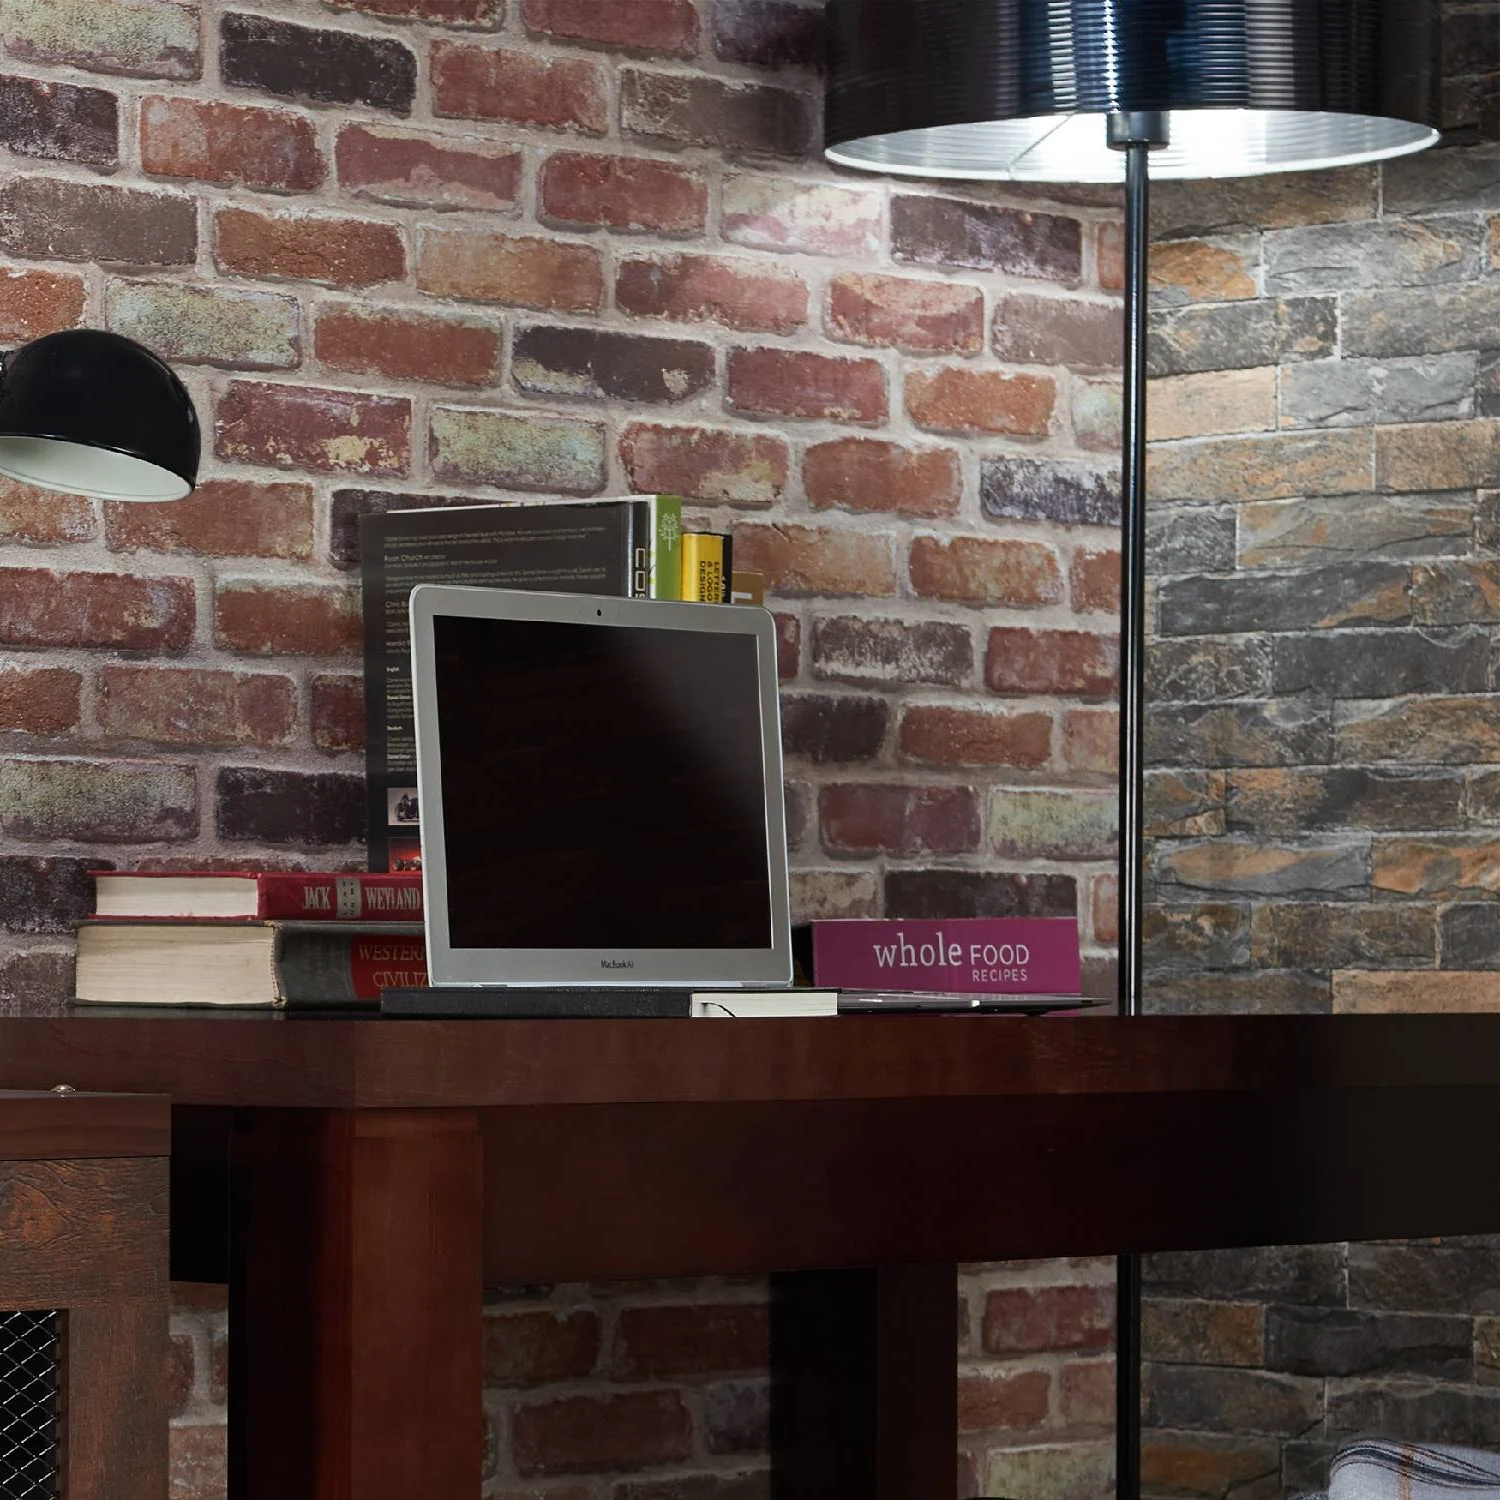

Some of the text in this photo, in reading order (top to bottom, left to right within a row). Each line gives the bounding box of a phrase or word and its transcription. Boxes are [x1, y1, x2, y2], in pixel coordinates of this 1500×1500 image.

[635, 547, 646, 598] CO
[302, 886, 421, 911] JACK WEYLAND
[358, 944, 425, 961] WESTER
[873, 932, 1030, 969] whole FOOD
[972, 969, 1028, 982] RECIPES
